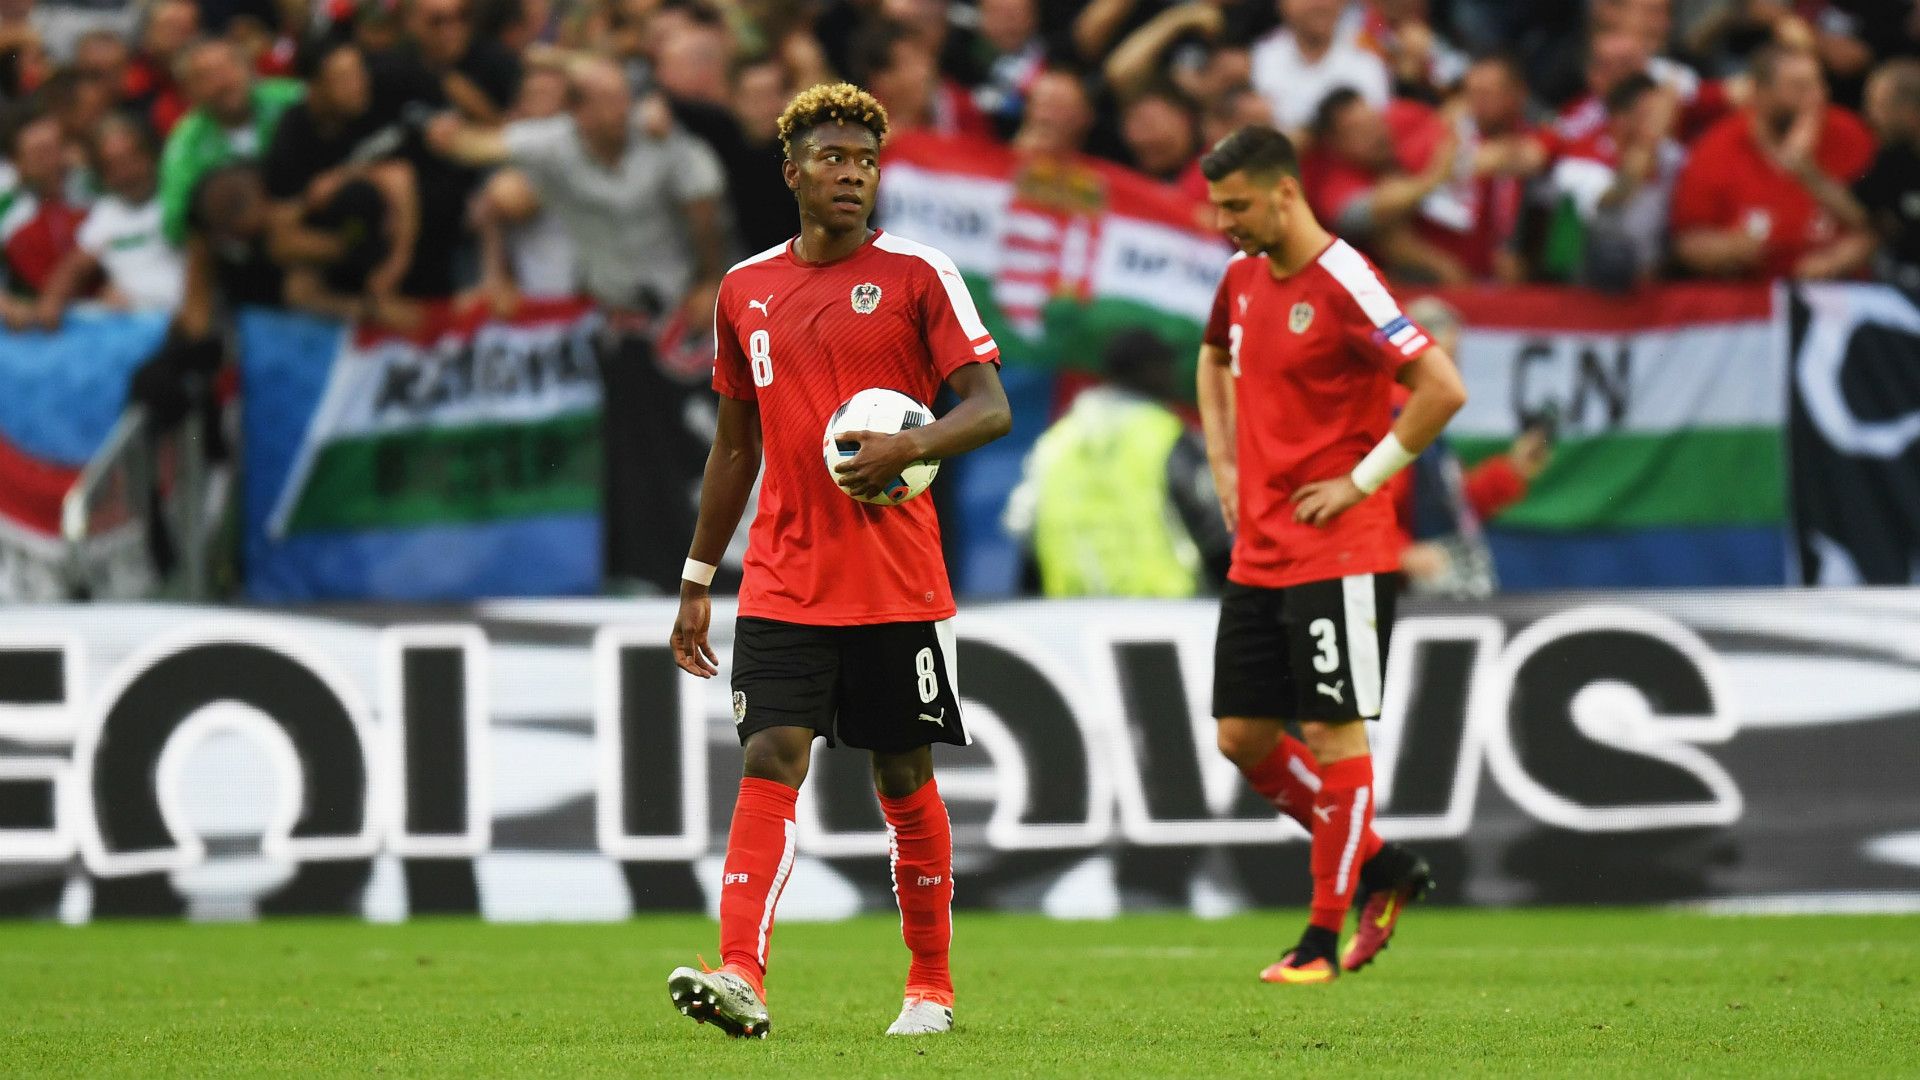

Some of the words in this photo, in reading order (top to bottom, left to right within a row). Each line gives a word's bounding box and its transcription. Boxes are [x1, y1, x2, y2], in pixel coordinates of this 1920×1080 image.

[750, 329, 774, 387] 8
[1309, 618, 1340, 674] 3
[915, 647, 939, 704] 8
